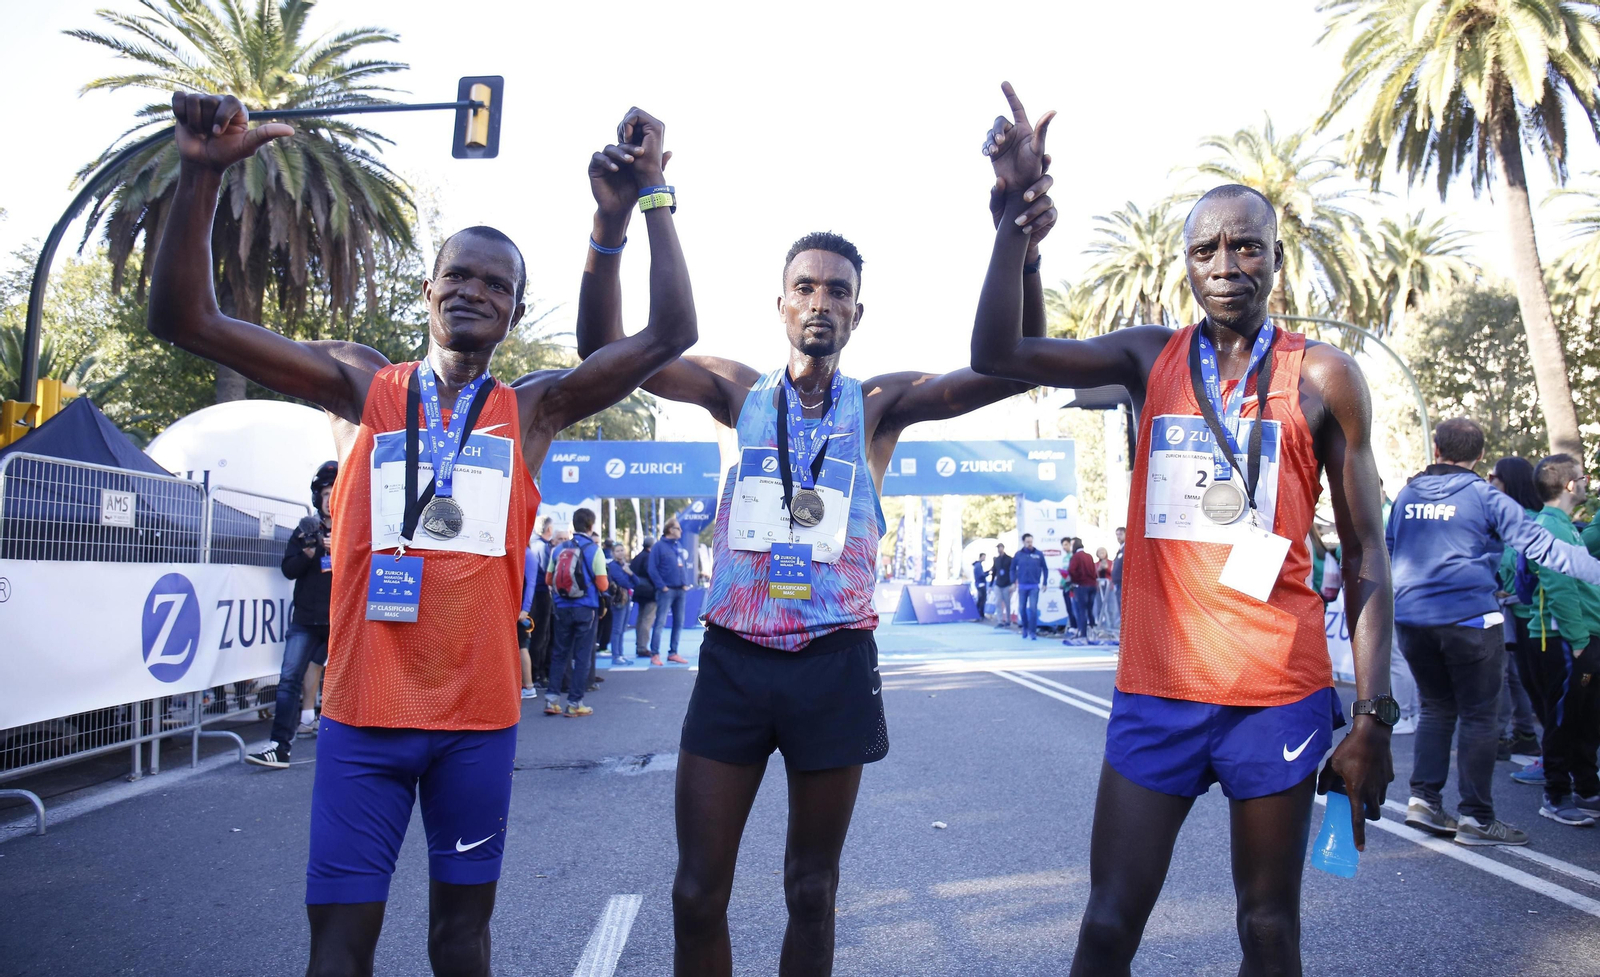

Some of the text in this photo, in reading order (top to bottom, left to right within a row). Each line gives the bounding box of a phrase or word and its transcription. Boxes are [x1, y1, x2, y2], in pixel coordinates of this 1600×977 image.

[629, 462, 683, 475] ZURICH
[959, 459, 1013, 473] ZURICH
[1195, 470, 1208, 488] 2
[106, 495, 129, 513] AMS
[1405, 503, 1456, 521] STAFF
[683, 513, 710, 521] ZURICH
[377, 604, 415, 613] CLASIFICADO
[216, 598, 294, 650] ZURI
